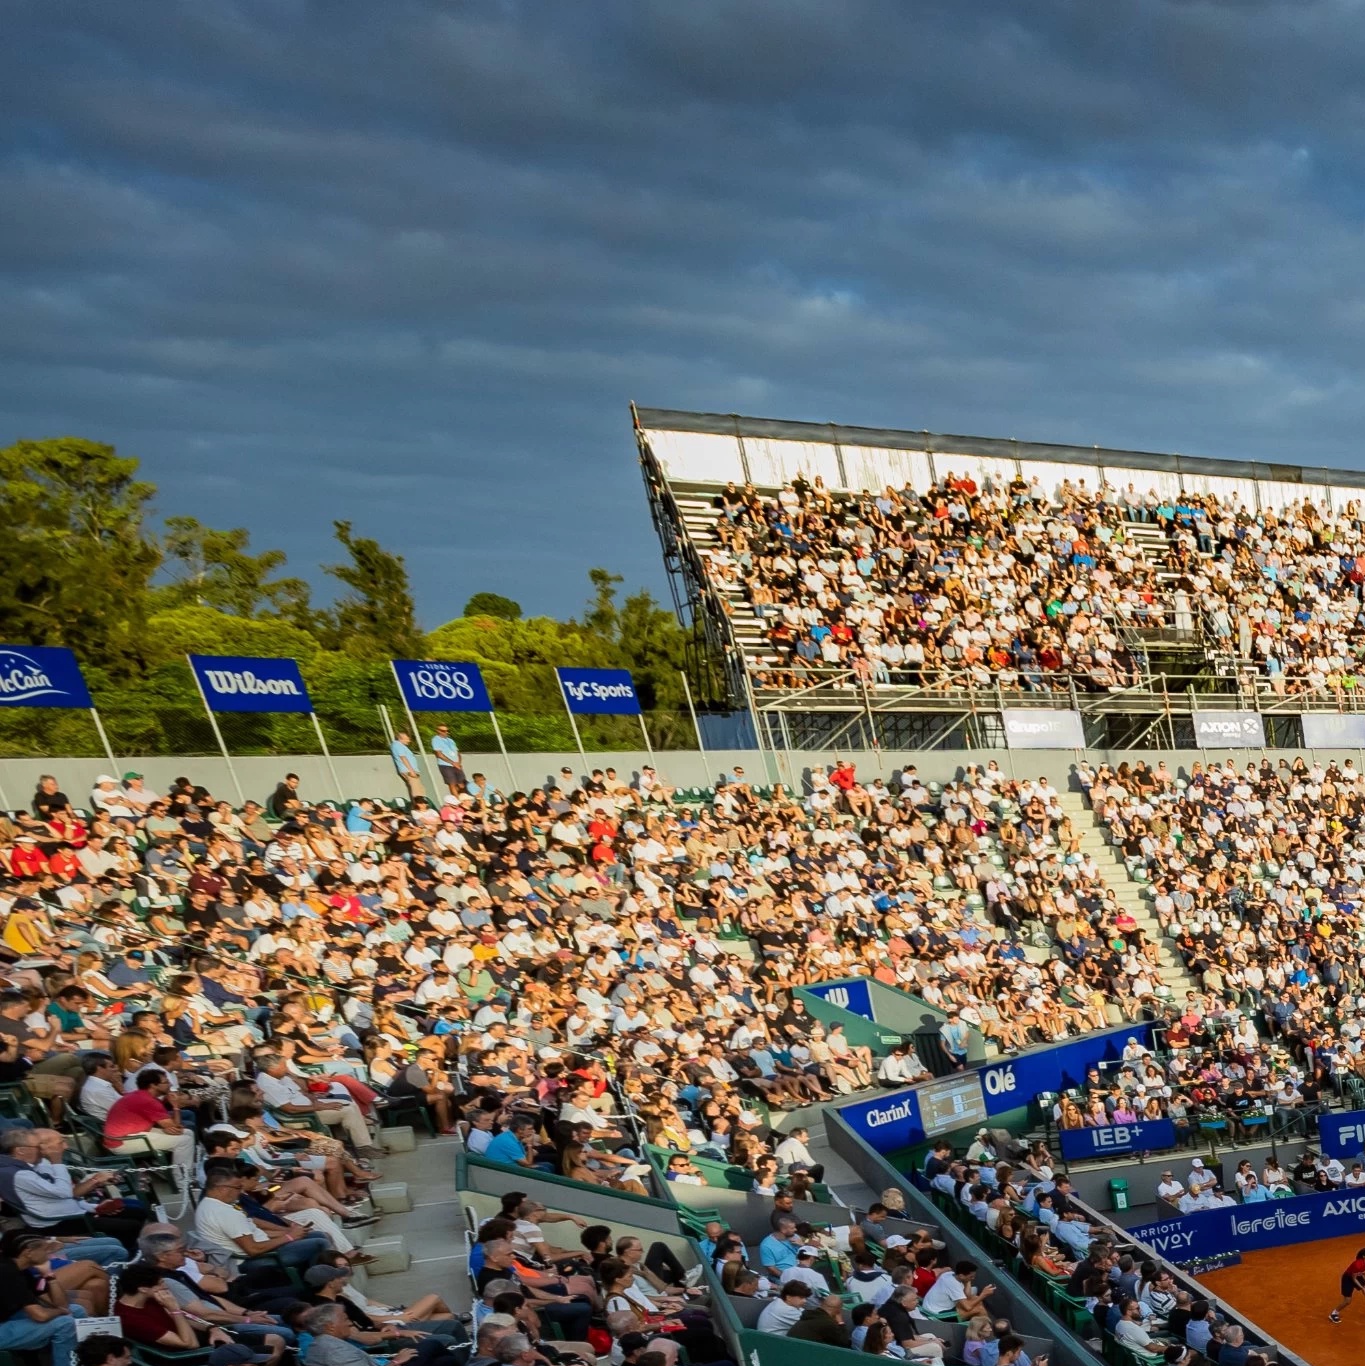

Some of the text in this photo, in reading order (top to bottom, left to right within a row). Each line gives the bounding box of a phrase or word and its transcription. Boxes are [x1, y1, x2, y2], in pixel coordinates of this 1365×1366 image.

[204, 669, 303, 695] Wilson
[408, 670, 475, 700] 1888
[564, 681, 634, 701] TyC Sports
[1200, 722, 1242, 734] AXION
[984, 1066, 1016, 1095] Olé
[1092, 1126, 1144, 1148] IEB+
[1133, 1222, 1182, 1243] ARRIOTT
[1143, 1231, 1194, 1252] NVOY
